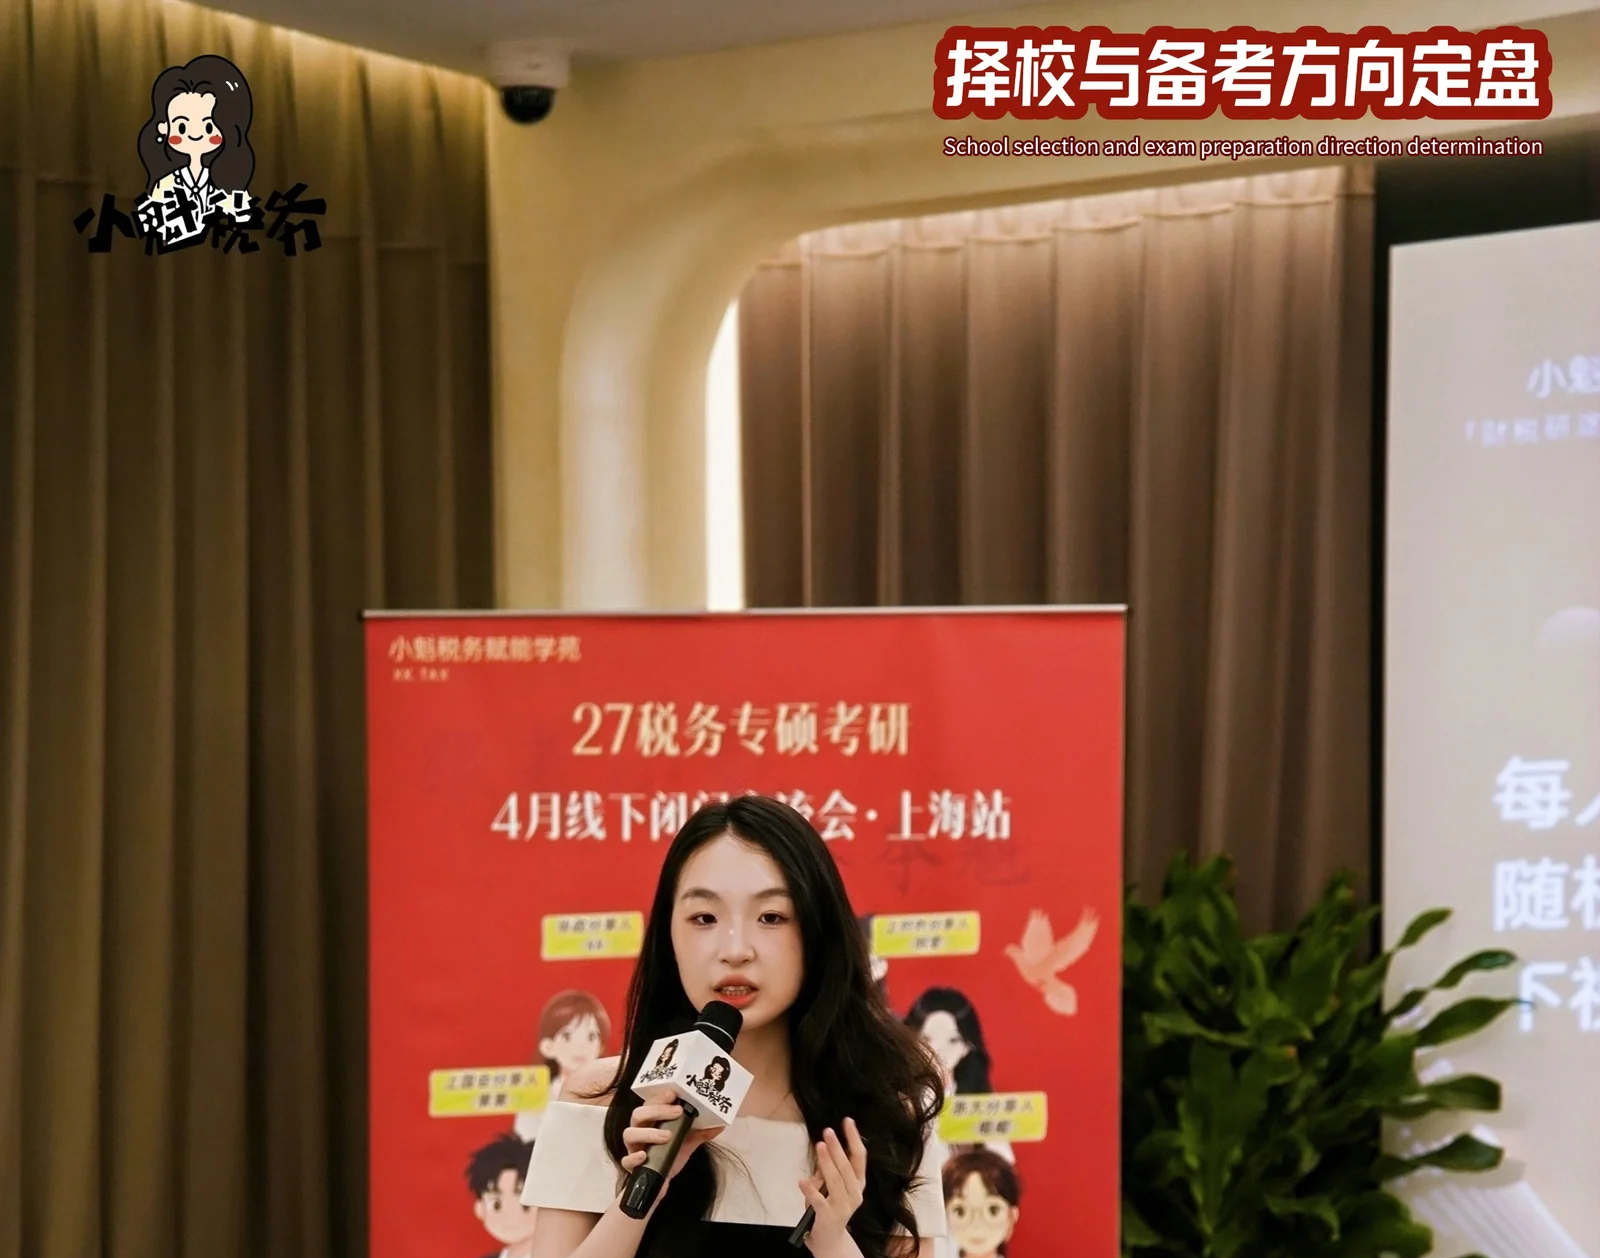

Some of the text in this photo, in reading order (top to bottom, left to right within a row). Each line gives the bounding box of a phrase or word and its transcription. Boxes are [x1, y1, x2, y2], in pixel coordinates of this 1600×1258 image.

[388, 635, 582, 662] 小魁税务赋能学苑
[572, 701, 911, 756] 27税务专硕考研
[490, 789, 1012, 842] 4月线下闭会·上海站
